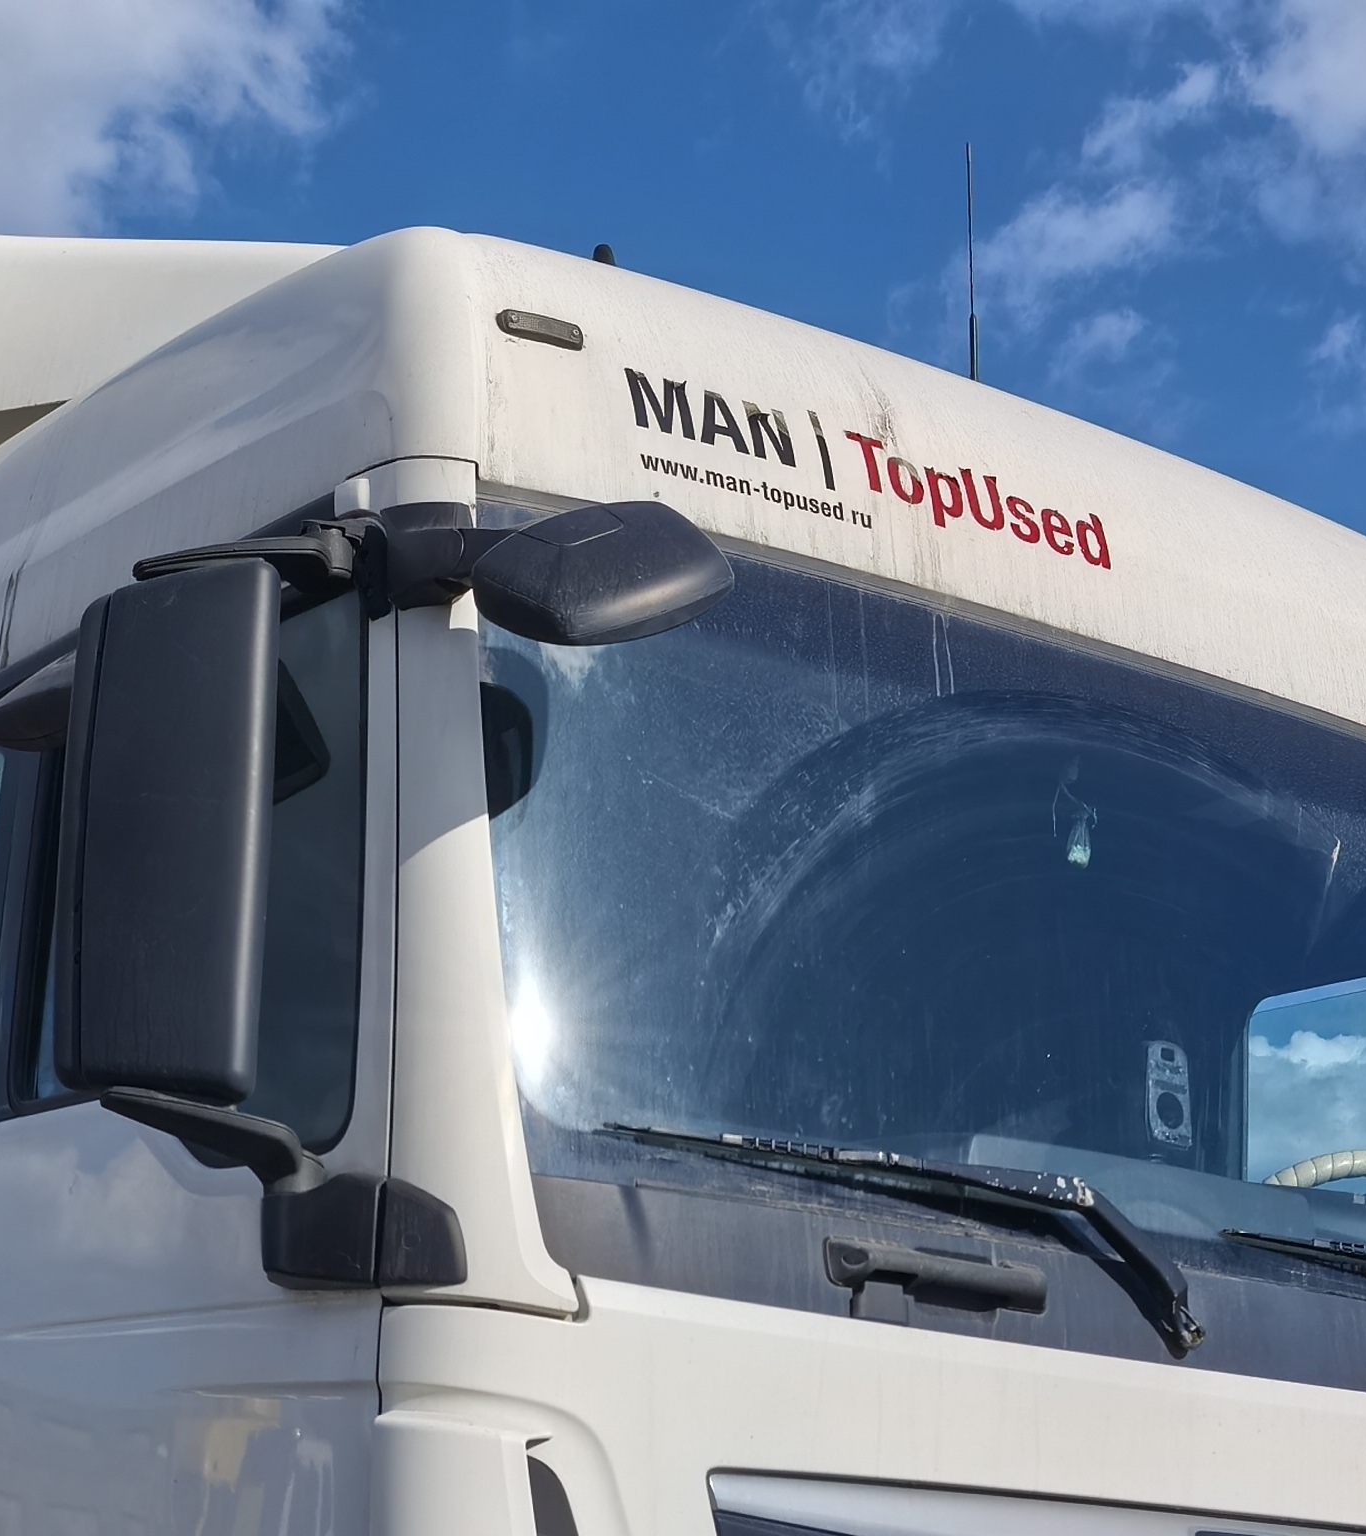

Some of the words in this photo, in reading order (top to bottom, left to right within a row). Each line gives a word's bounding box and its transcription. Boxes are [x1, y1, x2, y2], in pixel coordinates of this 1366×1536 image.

[623, 367, 797, 468] MAN
[843, 430, 1112, 570] TopUsed
[640, 453, 872, 529] www.man-topusedru
